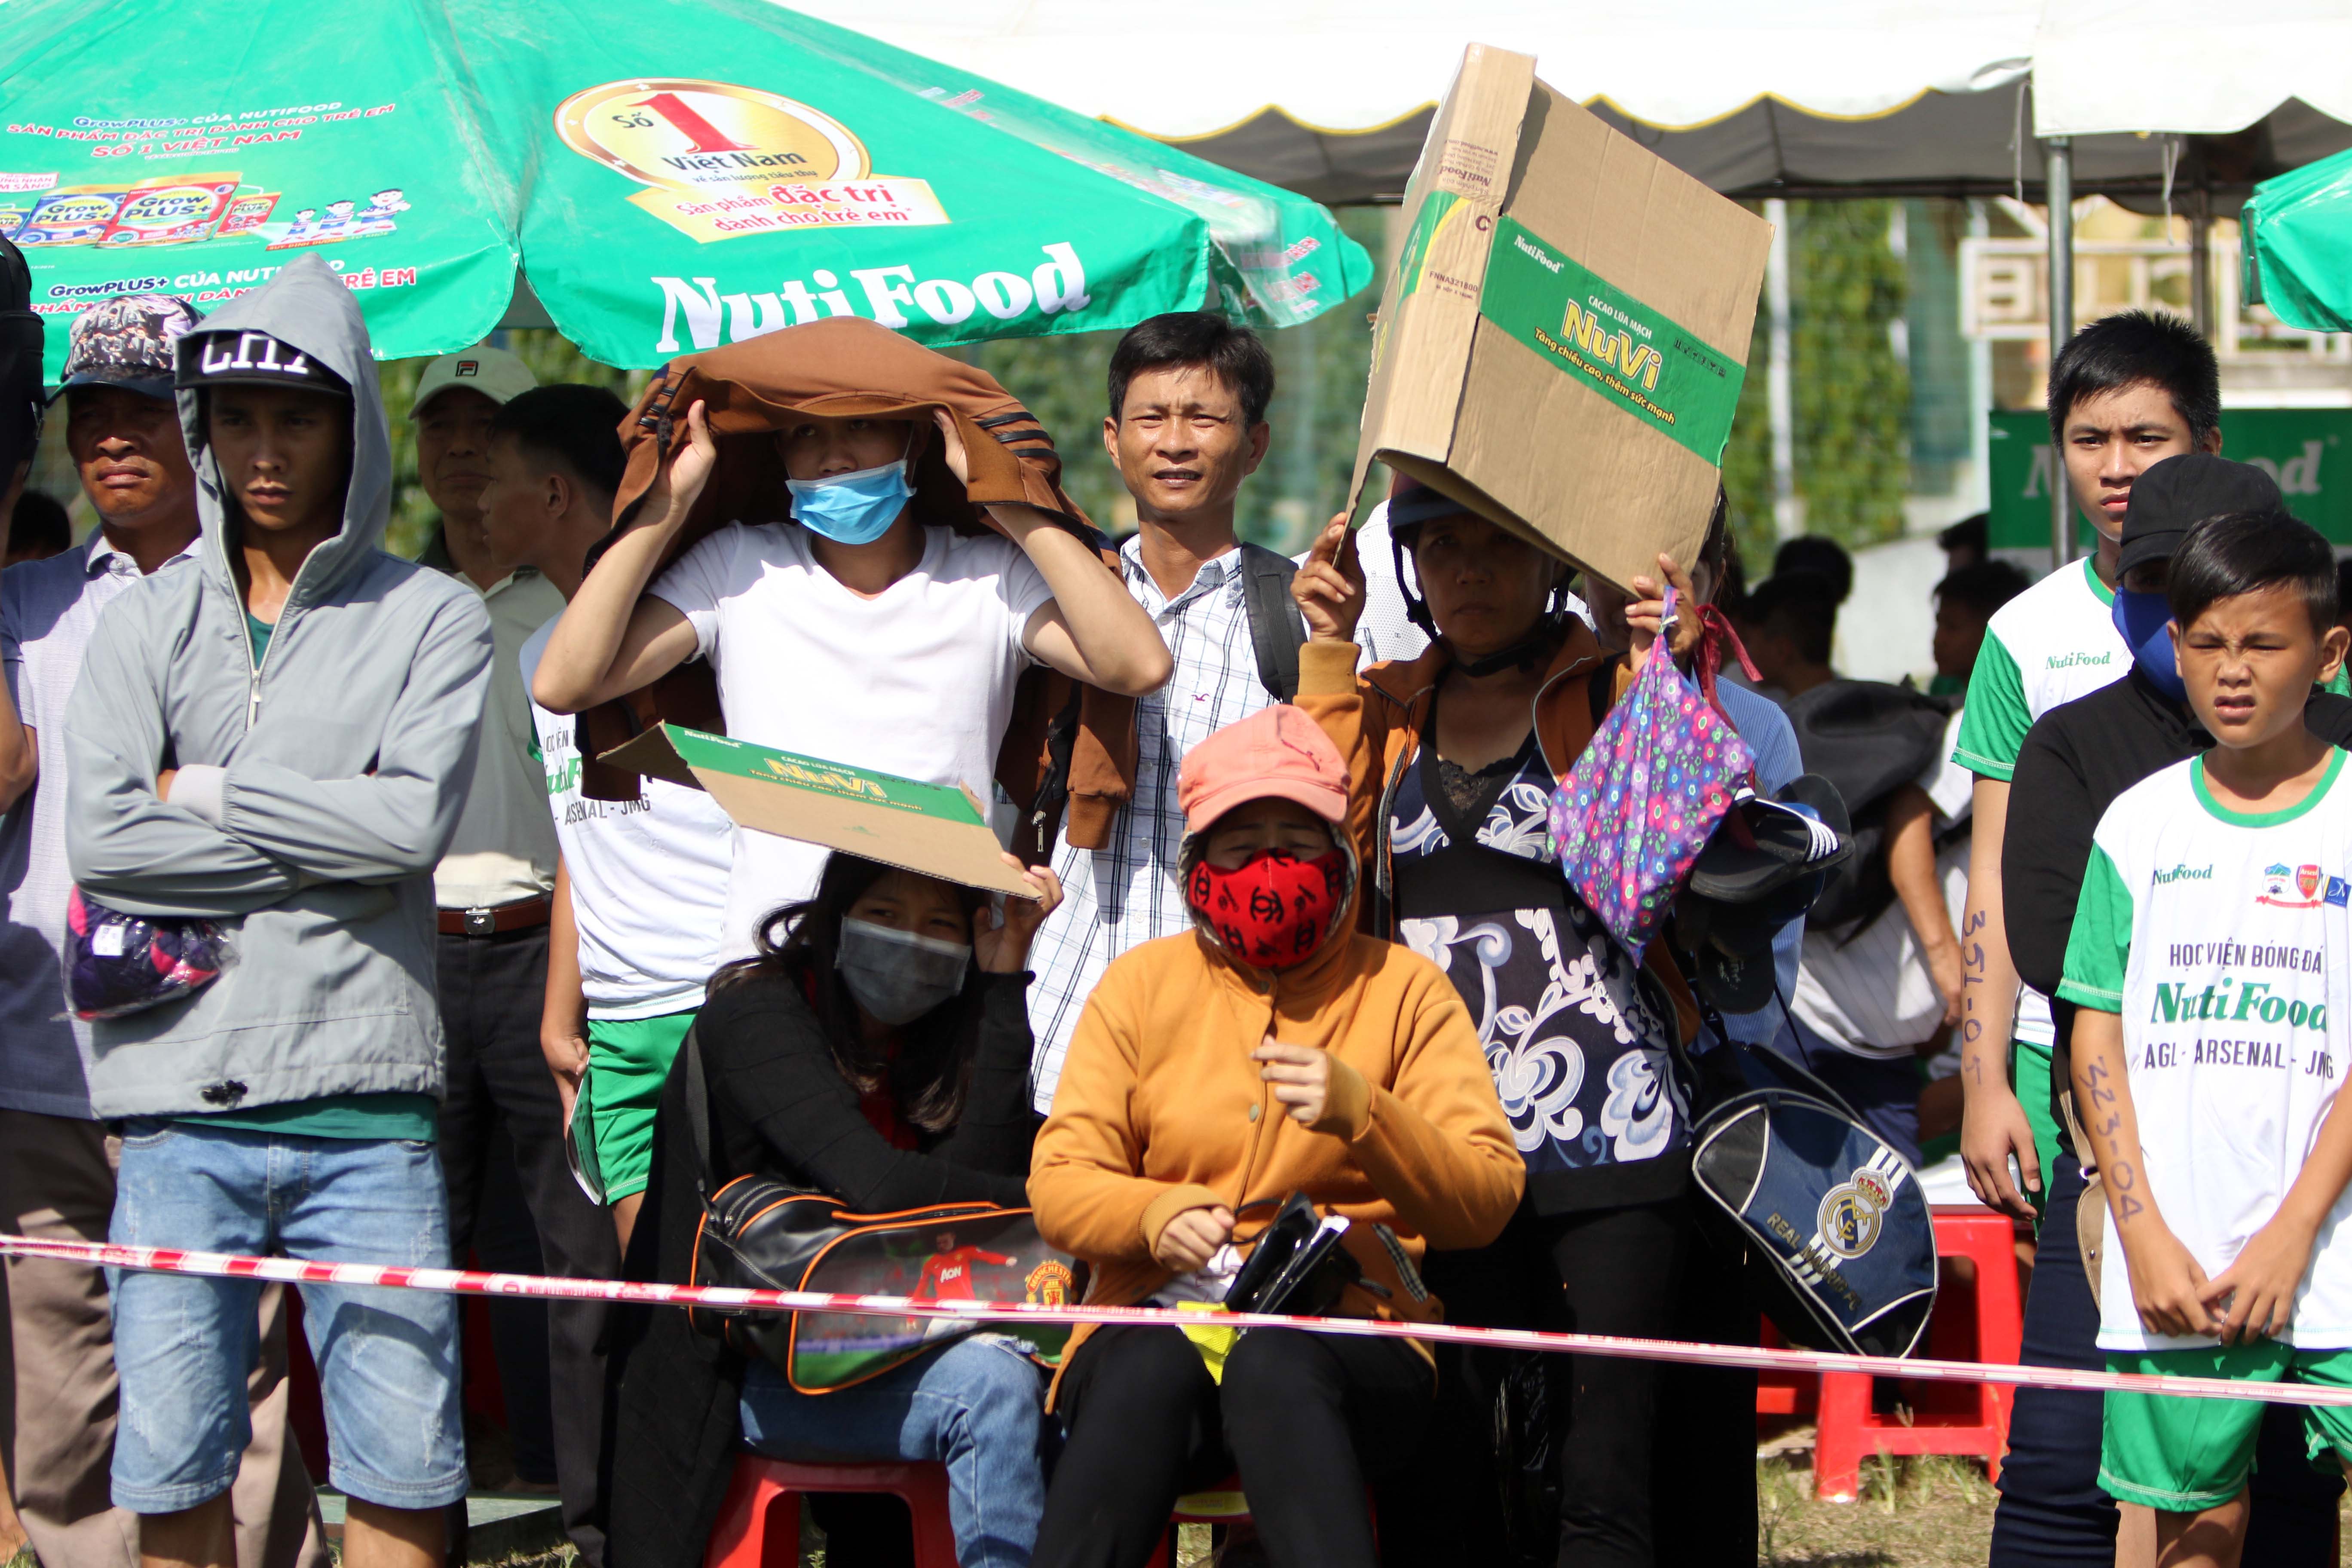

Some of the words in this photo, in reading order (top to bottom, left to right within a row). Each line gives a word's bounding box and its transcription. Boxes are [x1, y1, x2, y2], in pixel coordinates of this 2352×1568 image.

[239, 101, 343, 120] NUTIFOOD
[273, 116, 318, 128] CHO
[364, 103, 395, 118] EM
[611, 112, 654, 129] Số
[626, 92, 761, 154] 1
[138, 144, 153, 155] 1
[231, 129, 303, 147] NAM
[662, 151, 726, 173] Việt
[737, 151, 808, 168] Nam
[1437, 165, 1491, 187] NutiFood
[47, 204, 109, 214] Grow
[123, 205, 213, 219] PLUS+
[138, 195, 208, 208] Grow
[676, 201, 714, 216] Sản
[771, 184, 842, 209] đặc
[843, 184, 897, 208] trị
[714, 213, 776, 232] dành
[777, 208, 820, 224] cho
[820, 207, 863, 222] trẻ
[1475, 215, 1491, 231] C
[1514, 234, 1561, 274] NutiFood
[49, 276, 169, 298] GrowPLUS+
[174, 270, 221, 288] CỦA
[338, 267, 377, 290] RẺ
[380, 266, 417, 288] EM
[651, 241, 1091, 353] NutiFood
[1588, 295, 1613, 316] CACAO
[1613, 309, 1629, 326] LÚA
[1629, 318, 1652, 340] MẠCH
[1560, 298, 1663, 392] NuVi
[1534, 326, 1558, 352] Tăng
[1557, 344, 1584, 369] chiều
[1583, 362, 1605, 382] cao,
[1605, 373, 1631, 398] thêm
[1629, 390, 1647, 408] sức
[1646, 401, 1676, 426] mạnh
[2045, 651, 2111, 670] NutiFood
[764, 757, 888, 798] NuVi
[620, 793, 651, 816] JMG
[2152, 864, 2214, 886] NutFood
[2169, 943, 2204, 971] HỌC
[2207, 937, 2247, 971] VIỆN
[2251, 940, 2300, 970] BÓNG
[2301, 946, 2324, 974] ĐÁ
[1961, 910, 1987, 1085] 351-05
[2194, 1038, 2286, 1069] ARSENAL
[2079, 1055, 2144, 1225] 323-04
[1767, 1212, 1802, 1250] REAL
[940, 1265, 962, 1283] AON
